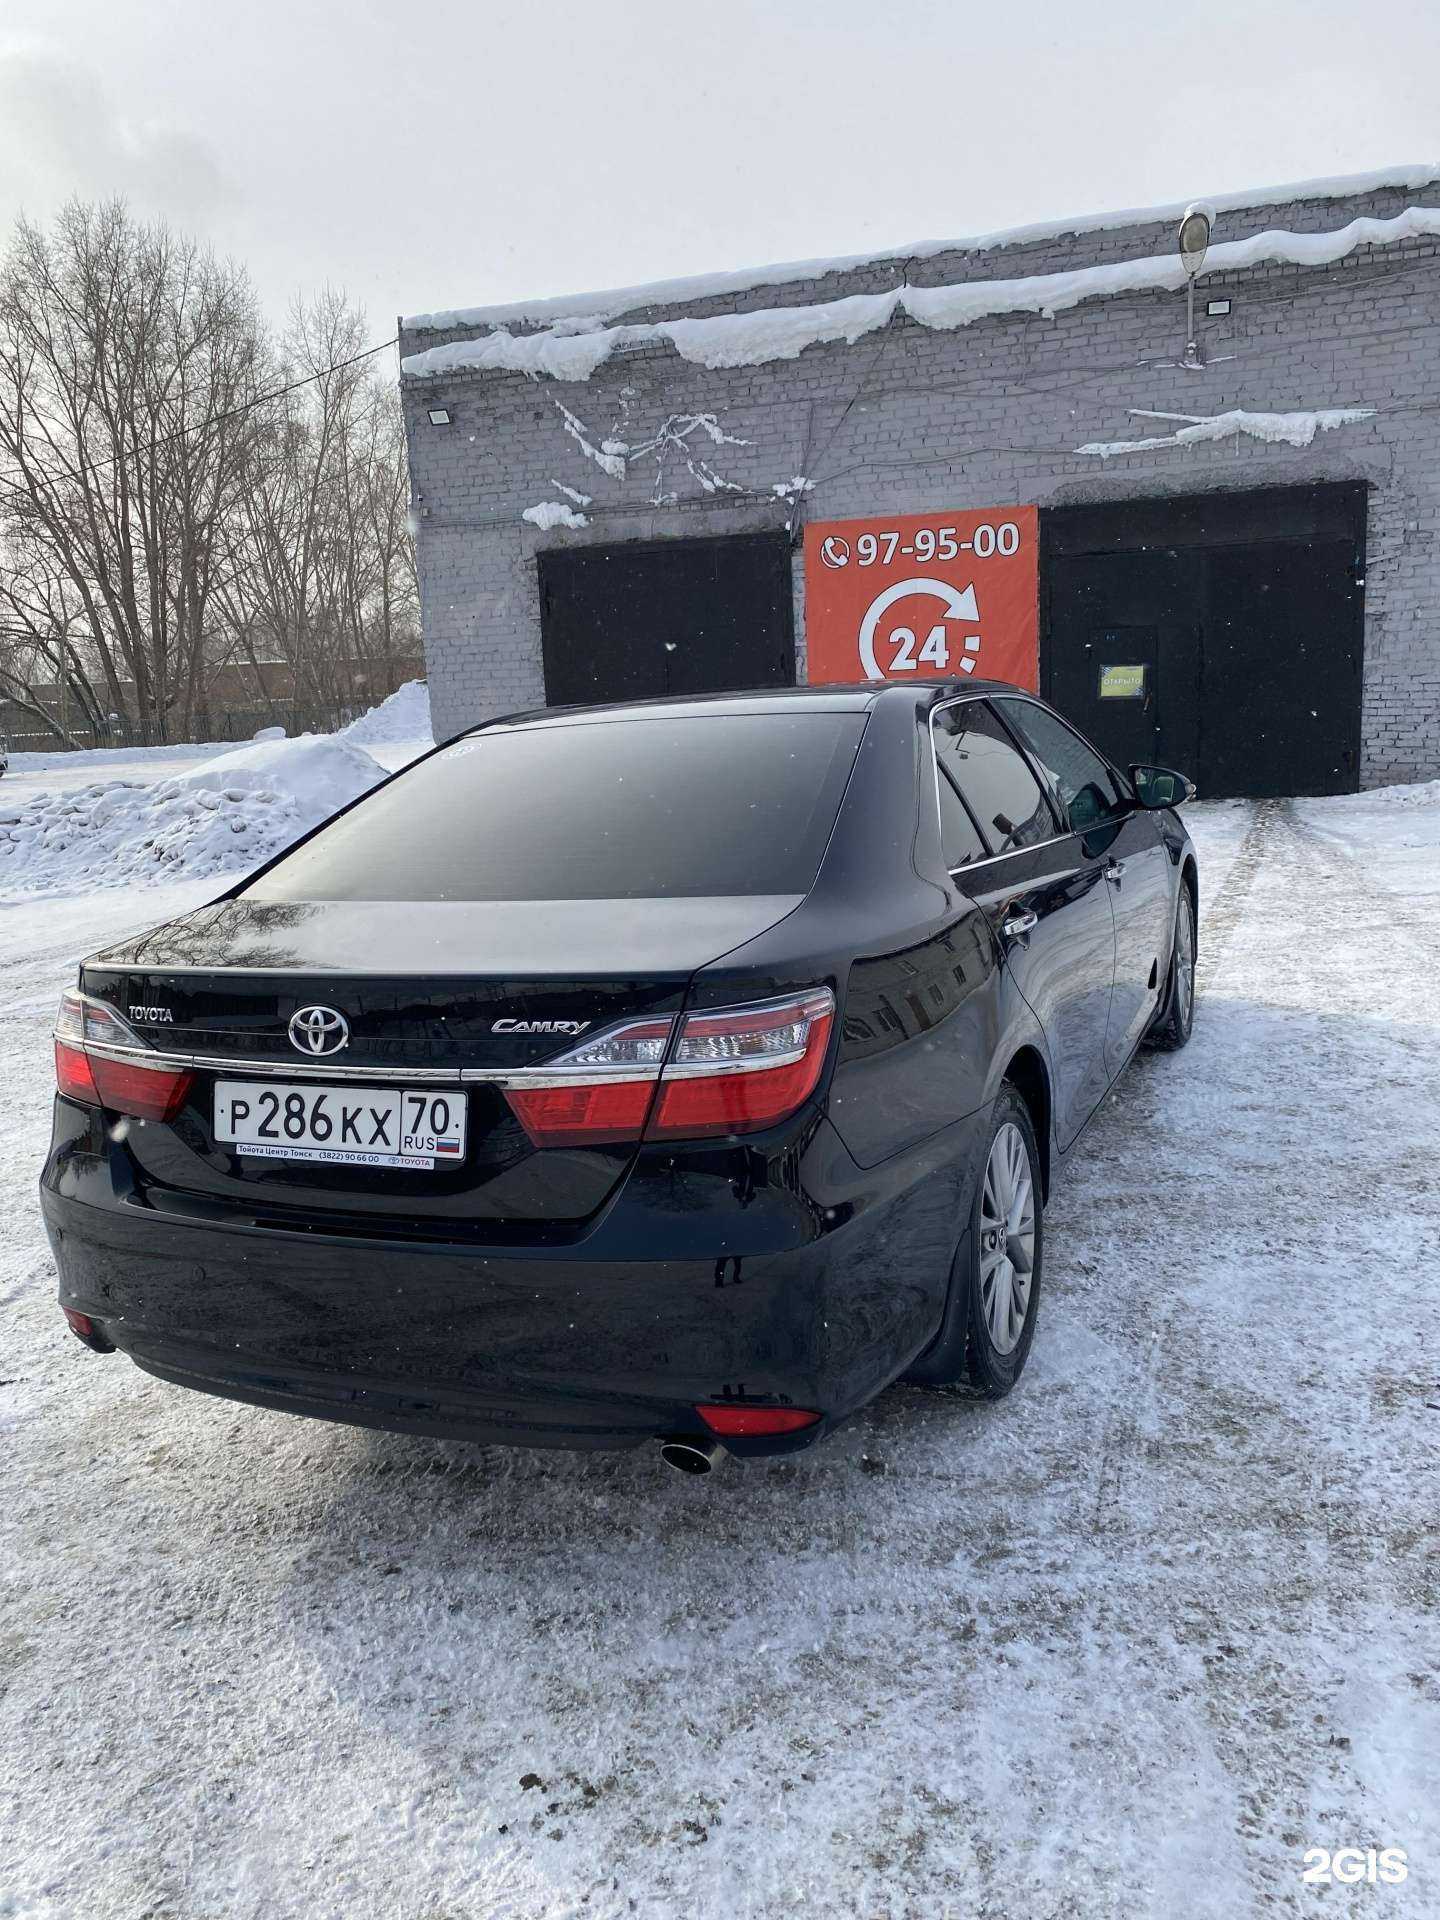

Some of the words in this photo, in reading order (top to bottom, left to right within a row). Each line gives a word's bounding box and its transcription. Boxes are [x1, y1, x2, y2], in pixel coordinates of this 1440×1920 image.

[856, 522, 1020, 567] 97-95-00
[888, 625, 950, 671] 24
[129, 1005, 173, 1023] TOYOTA
[407, 1097, 450, 1135] 70
[404, 1136, 435, 1151] RUS
[238, 1145, 264, 1155] Тойота
[265, 1146, 288, 1157] Центр
[290, 1149, 313, 1158] Томск
[318, 1150, 344, 1161] (3822)
[400, 1157, 430, 1167] TOYOTA
